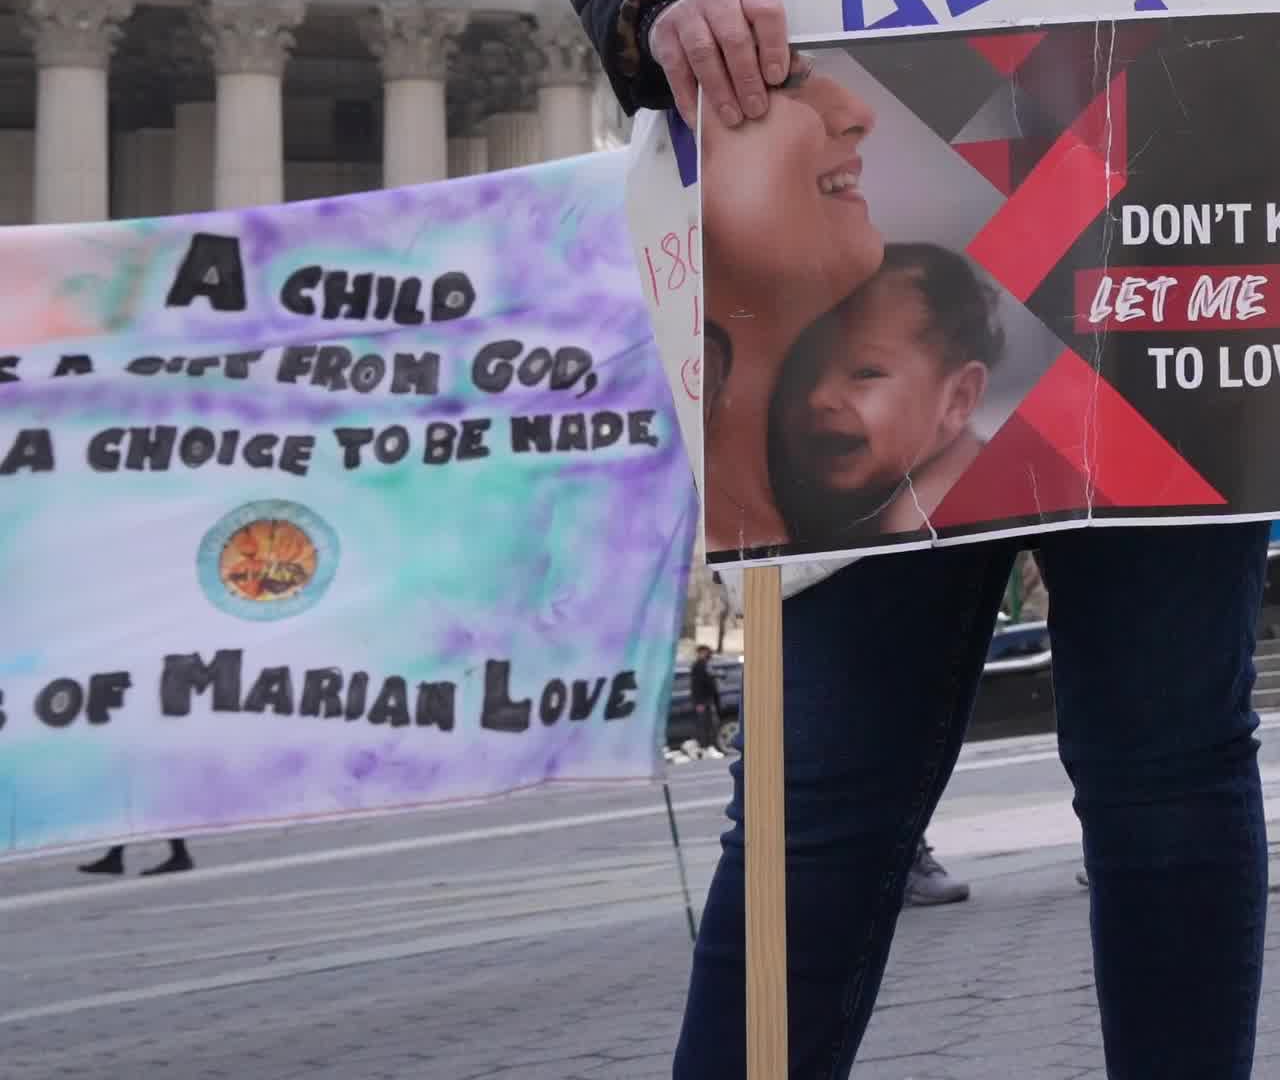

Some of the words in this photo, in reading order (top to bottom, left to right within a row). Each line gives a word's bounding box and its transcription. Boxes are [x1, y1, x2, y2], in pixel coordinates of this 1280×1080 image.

[1121, 203, 1252, 245] DON'T
[165, 232, 246, 311] A
[280, 265, 476, 325] CHILD
[1089, 276, 1178, 323] LET
[1187, 274, 1268, 322] ME
[276, 344, 441, 395] FROM
[471, 339, 598, 399] GOD,
[1148, 347, 1204, 389] TO
[0, 427, 55, 476] A
[86, 424, 316, 477] CHOICE
[334, 425, 410, 470] TO
[423, 417, 492, 465] BE
[510, 409, 659, 453] MADE
[34, 670, 132, 728] OF
[160, 648, 457, 733] MARIAN
[480, 658, 638, 733] LOVE
